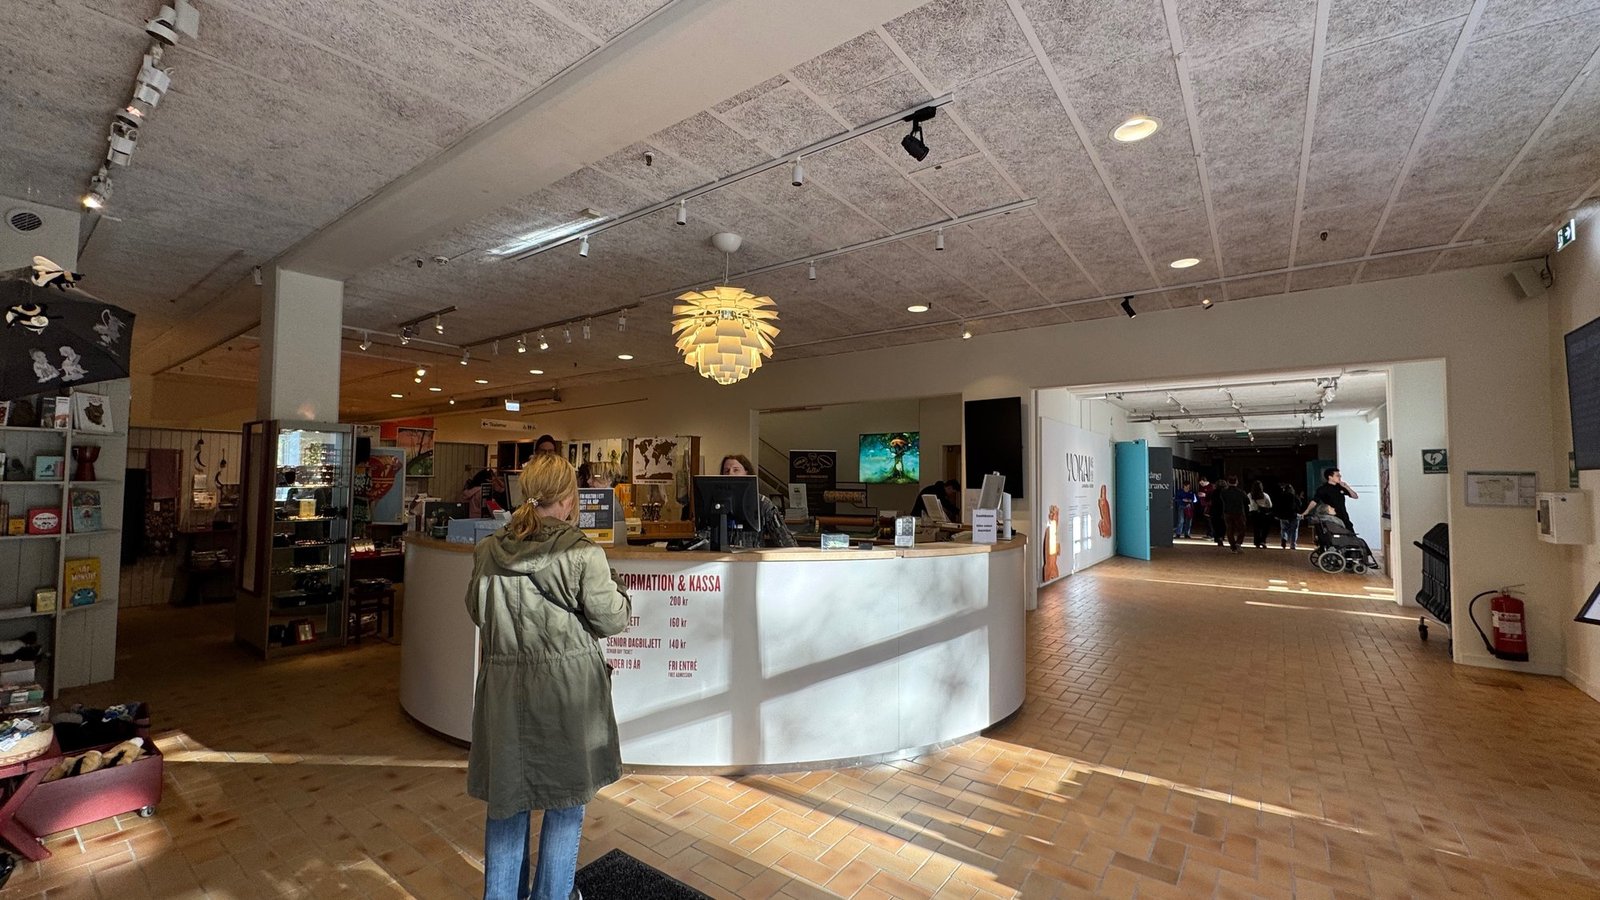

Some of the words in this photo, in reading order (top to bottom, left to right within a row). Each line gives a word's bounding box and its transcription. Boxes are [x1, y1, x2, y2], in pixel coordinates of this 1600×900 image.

[1066, 452, 1091, 482] YOKAI
[678, 574, 686, 591] &
[689, 575, 721, 592] KASSA
[669, 595, 681, 606] 200
[682, 595, 688, 606] kr
[669, 617, 680, 628] 160
[681, 617, 687, 628] kr
[606, 636, 627, 647] SENIOR
[628, 637, 661, 649] DAGBILJETT
[669, 638, 679, 649] 140
[680, 638, 687, 649] kr
[626, 659, 632, 669] 19
[668, 660, 678, 671] FRI
[679, 658, 698, 671] ENTRÉ
